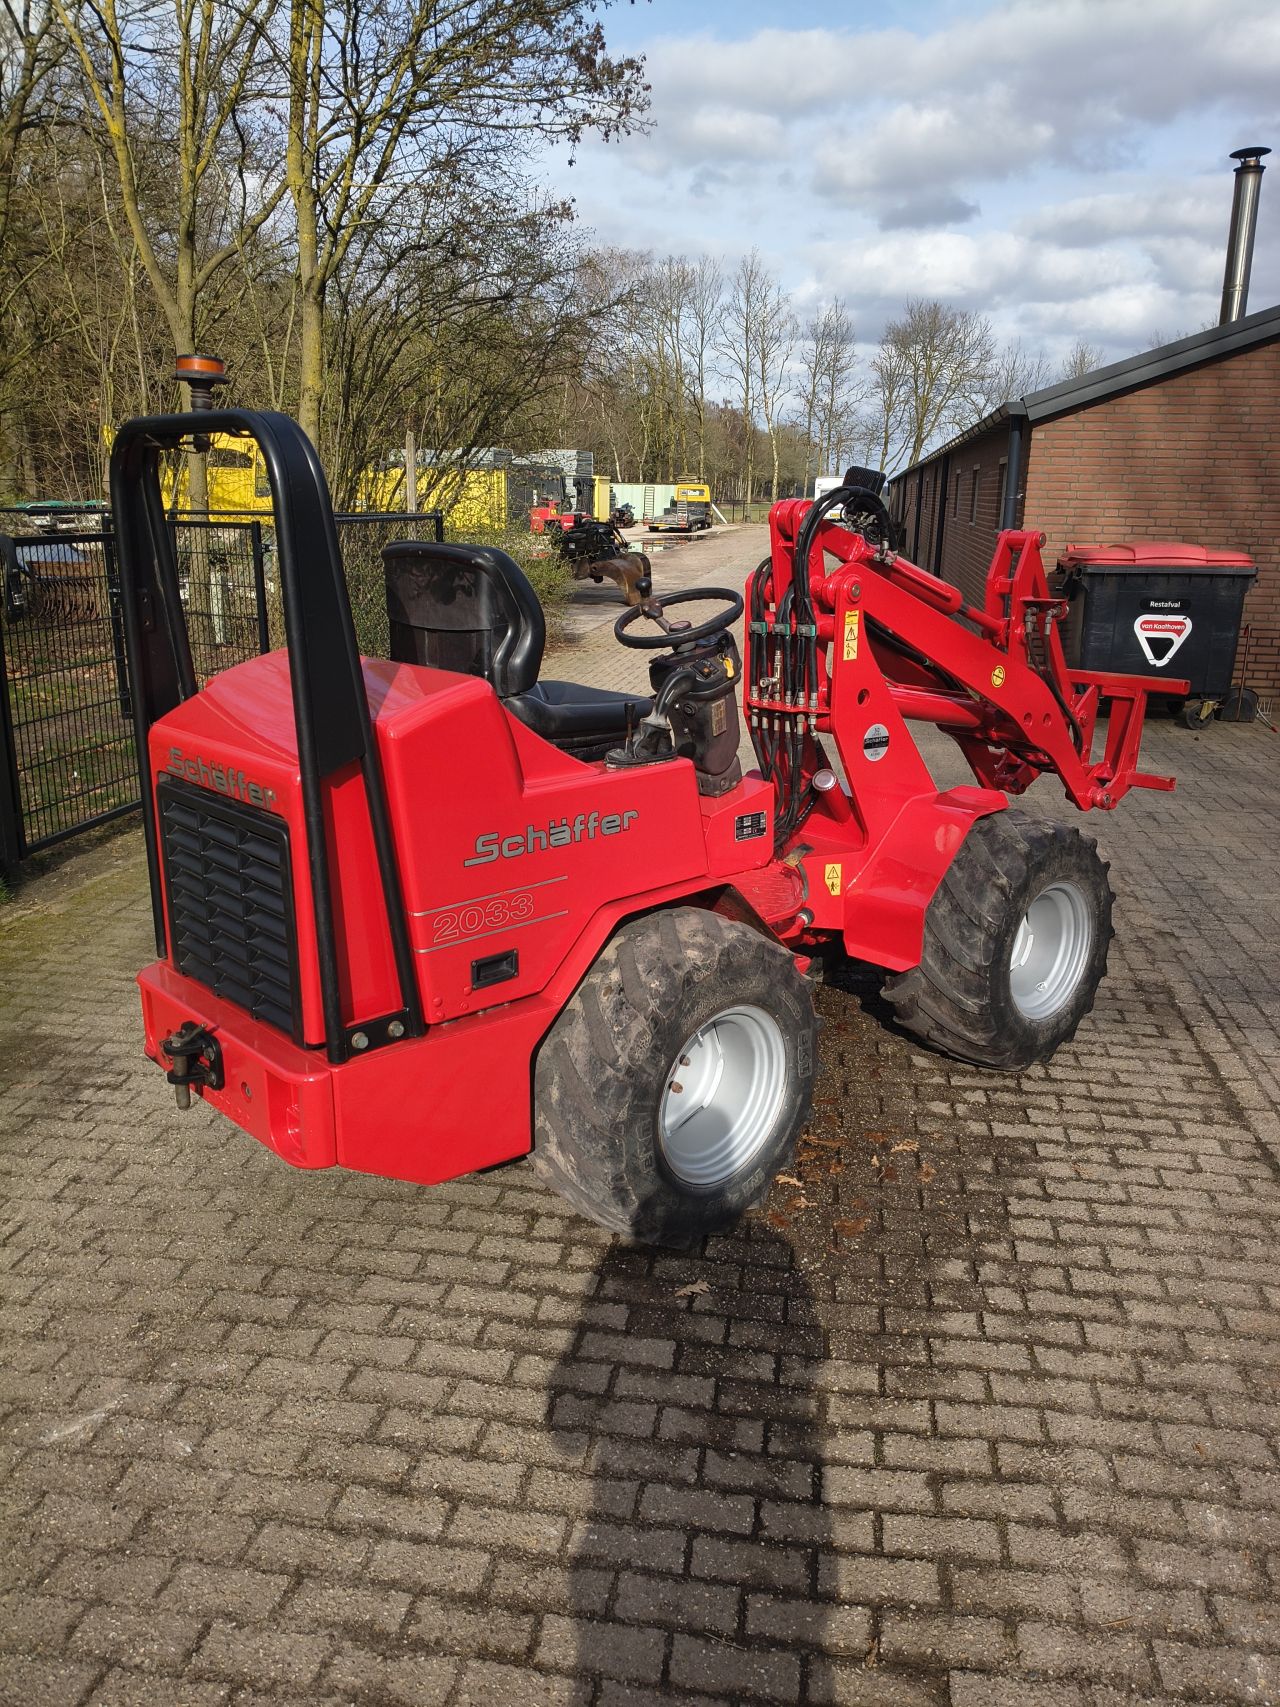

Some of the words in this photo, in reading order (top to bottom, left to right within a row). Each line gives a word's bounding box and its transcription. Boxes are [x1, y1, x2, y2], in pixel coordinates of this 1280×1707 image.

[166, 747, 277, 810] Schäffer
[463, 809, 639, 867] Schäffer
[433, 893, 535, 943] 2033
